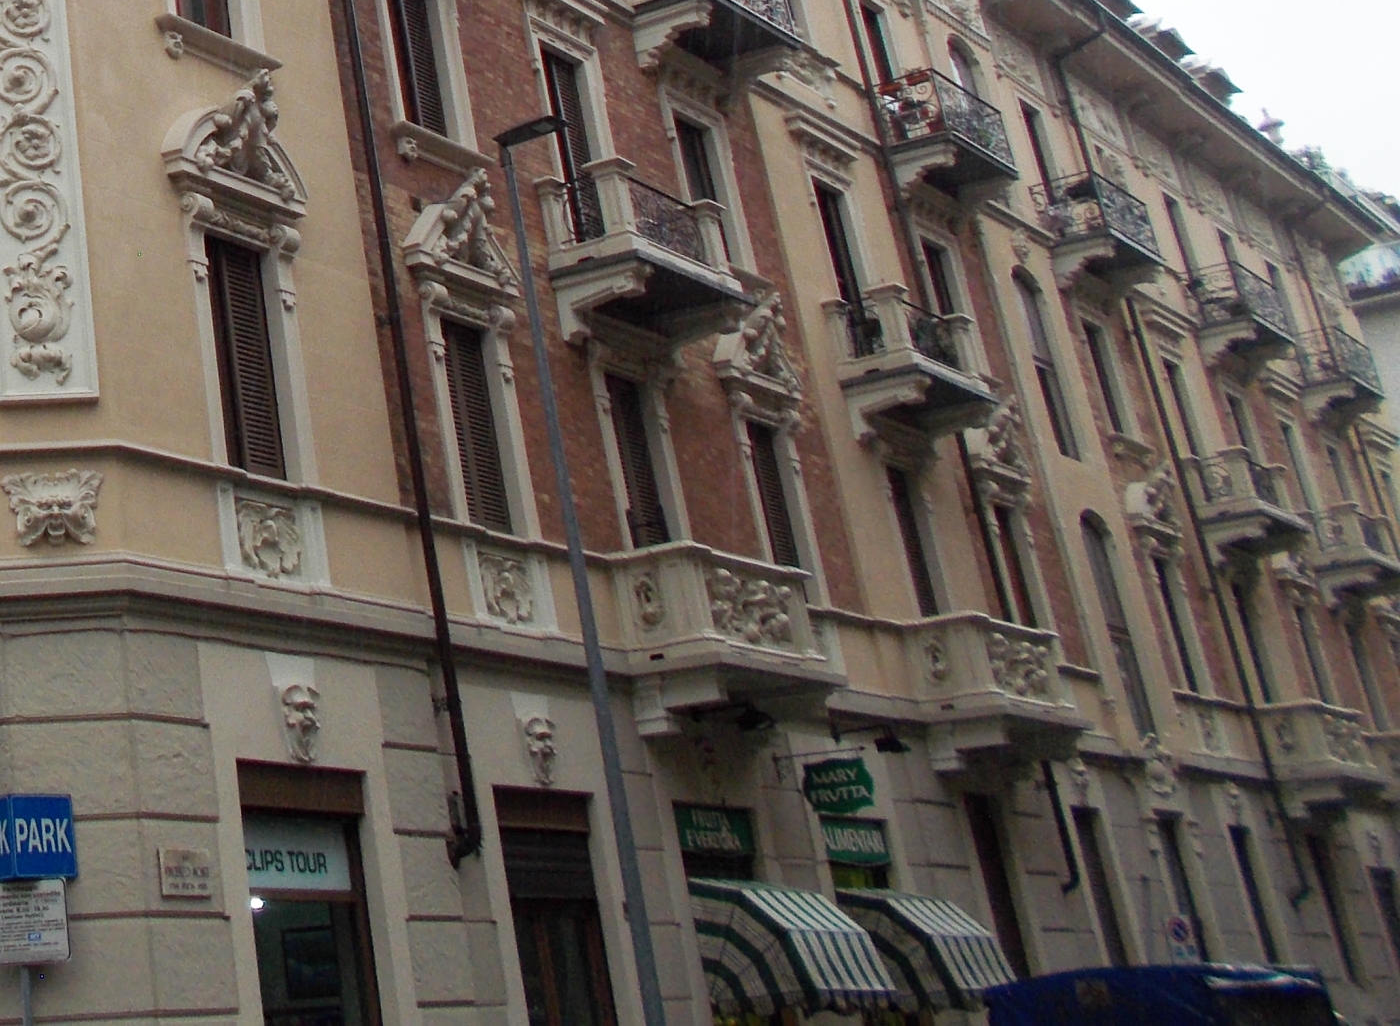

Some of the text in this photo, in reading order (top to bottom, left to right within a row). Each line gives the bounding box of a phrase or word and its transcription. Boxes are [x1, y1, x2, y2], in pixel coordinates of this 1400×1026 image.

[811, 768, 857, 785] MARY
[15, 818, 71, 853] PARK
[245, 848, 328, 874] CLIPS TOUR
